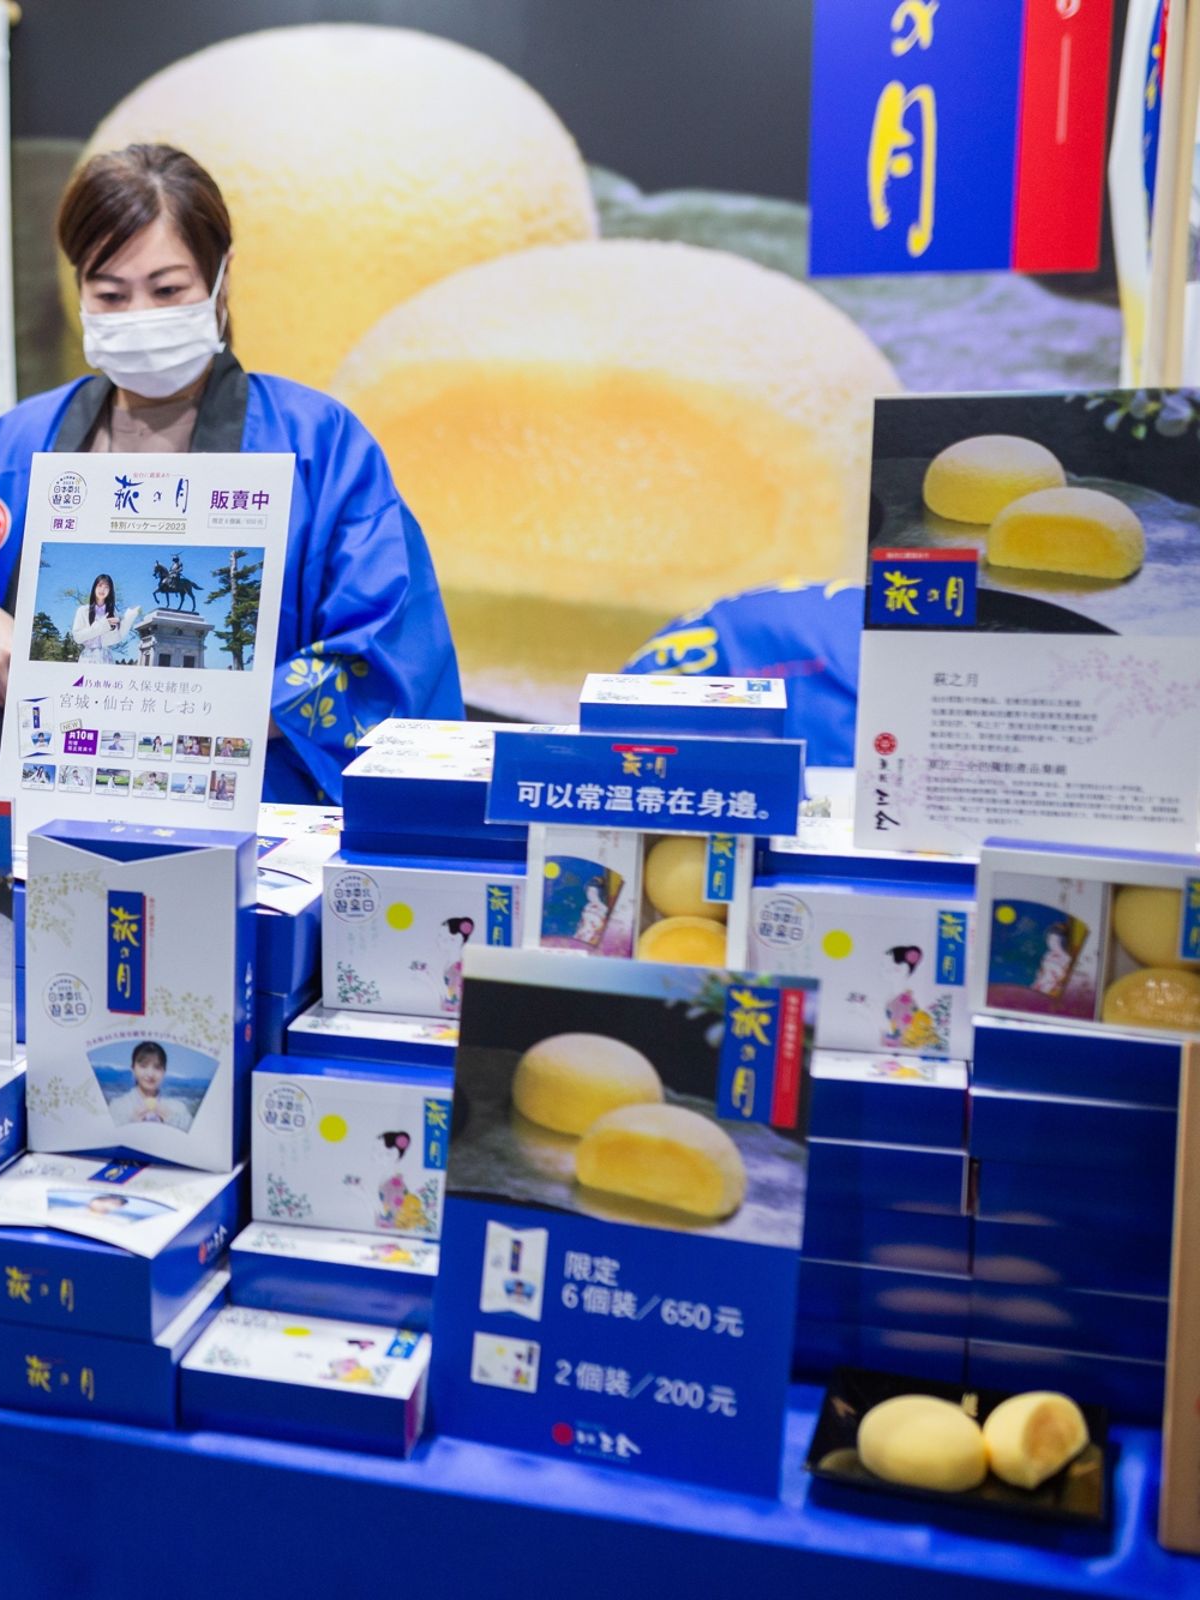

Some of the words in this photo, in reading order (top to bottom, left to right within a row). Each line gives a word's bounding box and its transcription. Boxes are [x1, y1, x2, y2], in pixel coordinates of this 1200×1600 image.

[115, 475, 189, 514] 萩の月
[210, 490, 271, 511] 販賣中
[53, 518, 76, 530] 限定
[110, 520, 187, 532] 特別パッケージ2023
[883, 571, 965, 617] 萩の月
[60, 692, 135, 711] 宮城・仙台
[140, 697, 213, 716] 旅しおり
[129, 679, 203, 694] 久保史緒里の
[110, 906, 142, 998] 萩の月
[730, 989, 776, 1118] 萩の月
[563, 1250, 621, 1287] 限定
[5, 1266, 75, 1312] 萩の月
[25, 1355, 95, 1401] 萩の月
